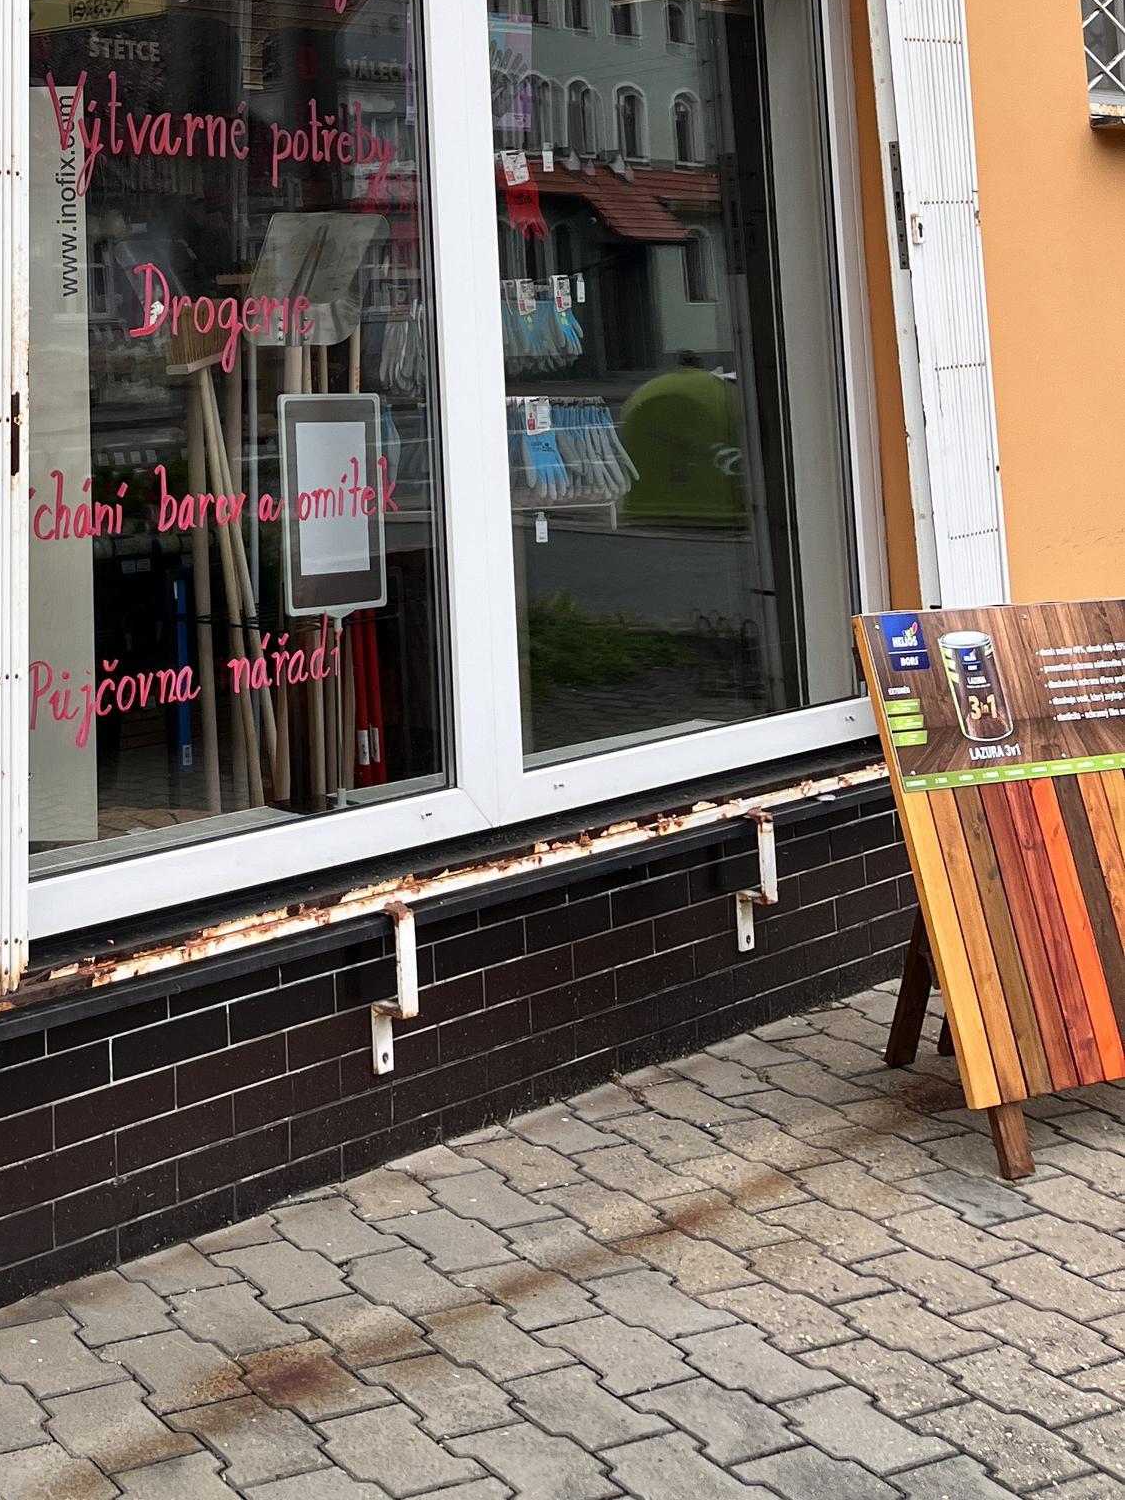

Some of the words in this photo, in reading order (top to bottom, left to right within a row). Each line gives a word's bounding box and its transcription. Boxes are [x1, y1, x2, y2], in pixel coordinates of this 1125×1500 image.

[88, 28, 161, 62] ŠTĚTCE
[45, 69, 251, 198] Výtvarné
[271, 98, 398, 198] potřeby
[127, 262, 316, 374] Drogerie
[28, 469, 128, 542] chání
[257, 492, 286, 522] a
[297, 455, 401, 519] omítek
[28, 658, 202, 749] Půjčovna
[226, 609, 345, 695] nářadí
[892, 636, 918, 648] HELIOS
[969, 747, 1005, 761] LAZURA
[1004, 744, 1022, 757] 3v1
